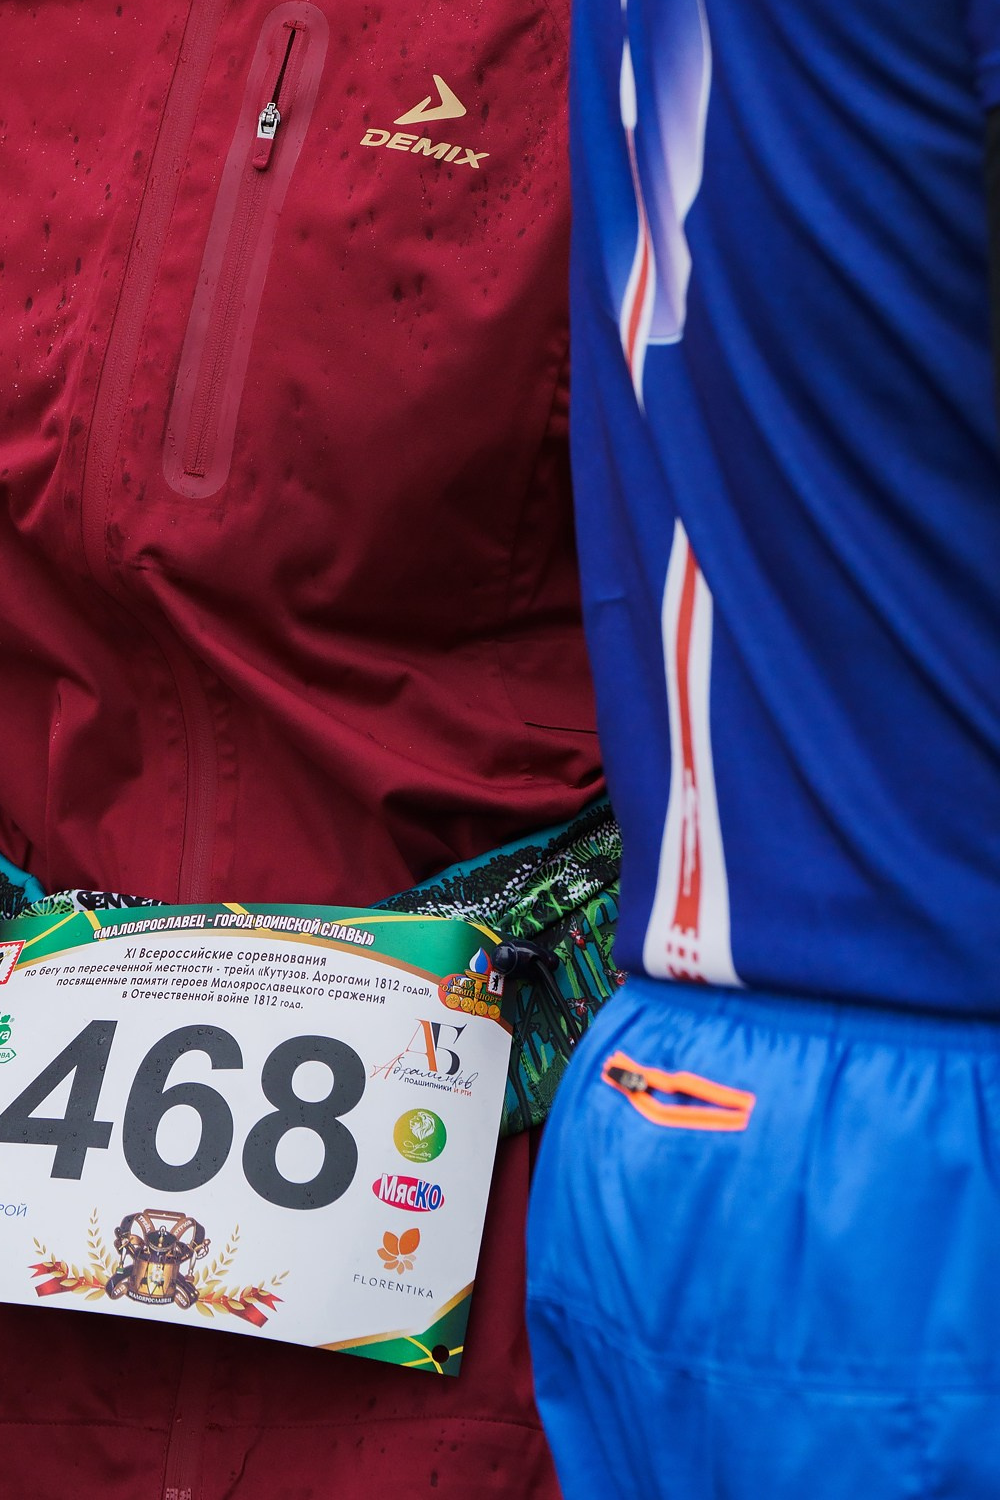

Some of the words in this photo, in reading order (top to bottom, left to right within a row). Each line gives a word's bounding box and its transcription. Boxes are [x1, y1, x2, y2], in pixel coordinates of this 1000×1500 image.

[359, 128, 490, 169] DEMIX
[93, 914, 206, 940] «МАЛОЯРОСЛАВЕЦ
[213, 913, 253, 929] ГОРОД
[254, 913, 320, 935] ВОИНСКОЙ
[320, 922, 375, 946] СЛАВЫ»
[138, 947, 233, 962] Всероссийские
[237, 951, 327, 967] соревнования
[24, 968, 37, 977] по
[39, 965, 62, 977] бегу
[63, 965, 75, 974] по
[77, 962, 153, 976] пересеченной
[154, 964, 213, 974] местности
[223, 963, 255, 977] трейл
[258, 965, 309, 981] «Кутузов.
[312, 970, 372, 988] Дорогами
[374, 977, 400, 991] 1812
[56, 976, 128, 987] посвященные
[130, 977, 168, 986] памяти
[170, 978, 208, 990] героев
[210, 977, 325, 998] Малоярославецкого
[327, 989, 386, 1005] сражения
[121, 990, 128, 999] в
[131, 988, 214, 1002] Отечественной
[216, 993, 250, 1005] войне
[253, 994, 278, 1007] 1812
[280, 998, 304, 1010] года.
[404, 1076, 452, 1092] ПОДШИПНИКИ
[460, 1088, 472, 1097] РТИ
[353, 1273, 434, 1299] FLORENTIKA
